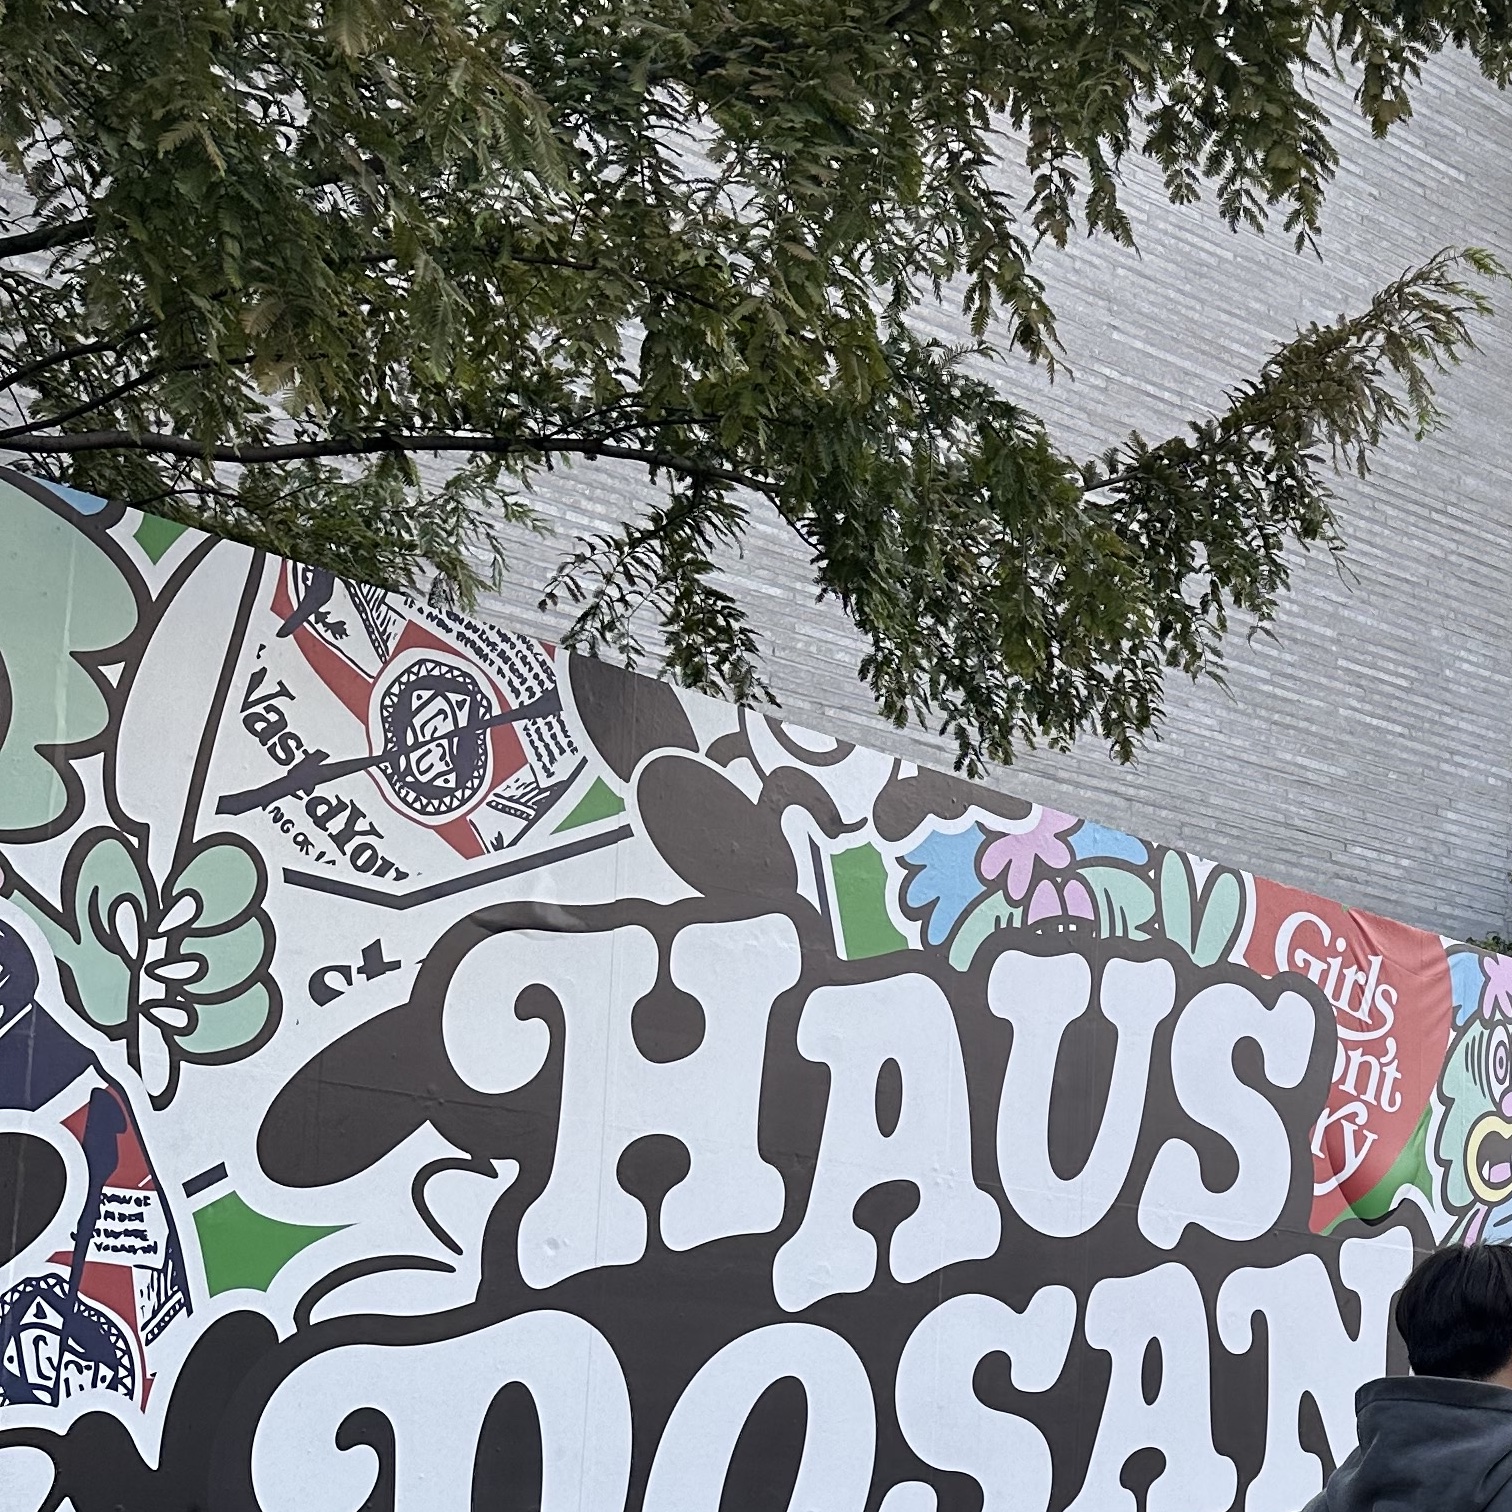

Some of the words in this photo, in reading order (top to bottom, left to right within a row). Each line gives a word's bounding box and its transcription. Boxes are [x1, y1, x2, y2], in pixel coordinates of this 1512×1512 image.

[1274, 911, 1398, 1041] Girls
[441, 911, 1318, 1312] HAUS
[1311, 1102, 1378, 1196] ry
